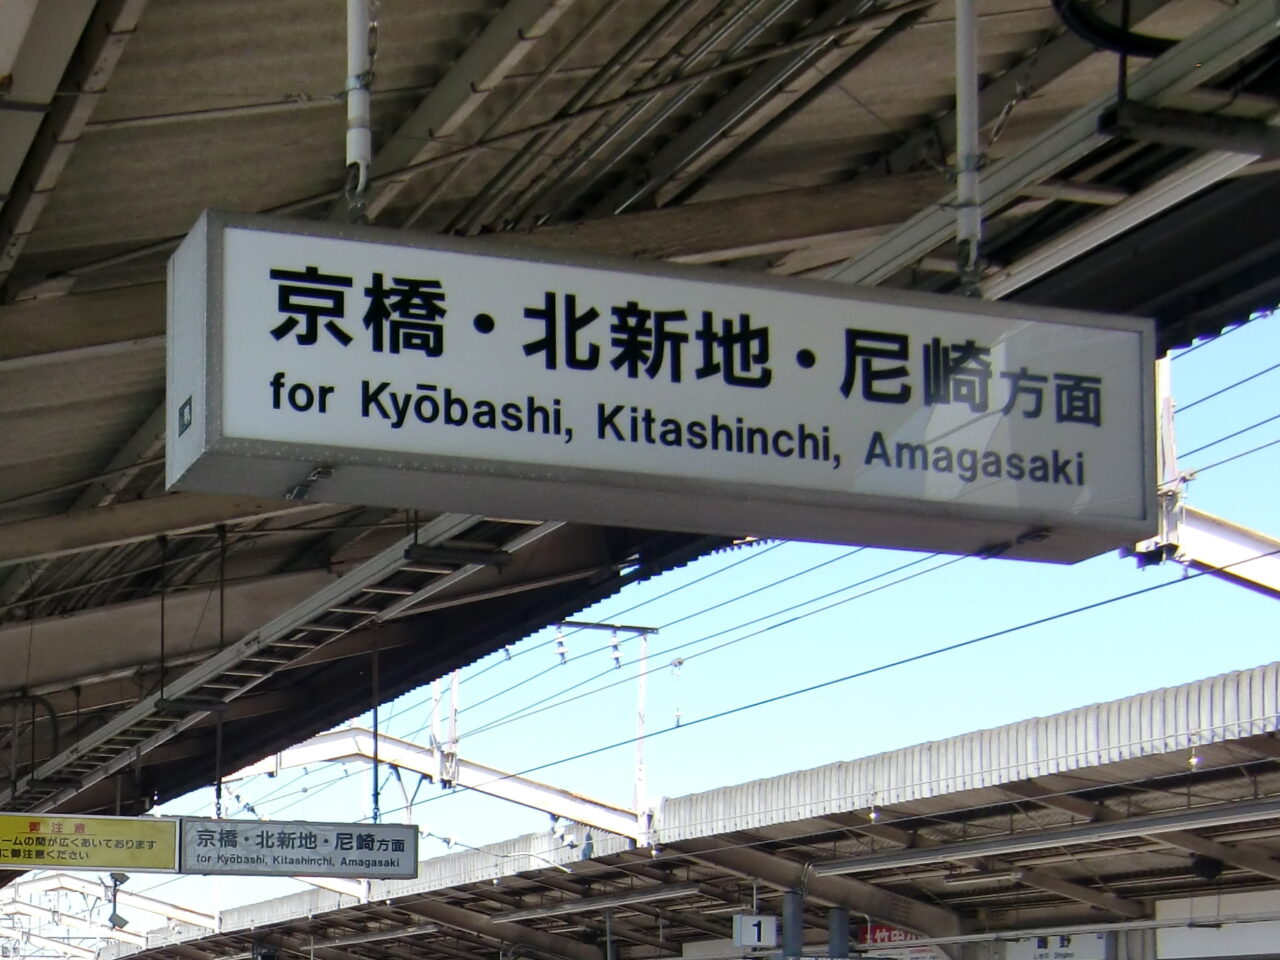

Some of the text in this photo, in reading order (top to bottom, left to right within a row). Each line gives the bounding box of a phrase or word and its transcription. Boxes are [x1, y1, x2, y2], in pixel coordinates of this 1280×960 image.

[269, 265, 1102, 427] 京橋・北新地・尼崎方面
[269, 371, 1085, 486] for Kyōbashi, Kitashinchi, Amagasaki
[196, 829, 405, 853] 京橋・北新地・尼崎方面
[196, 853, 400, 869] for Kyōbashi, Kitashinchi, Amagasaki
[752, 920, 762, 943] 1
